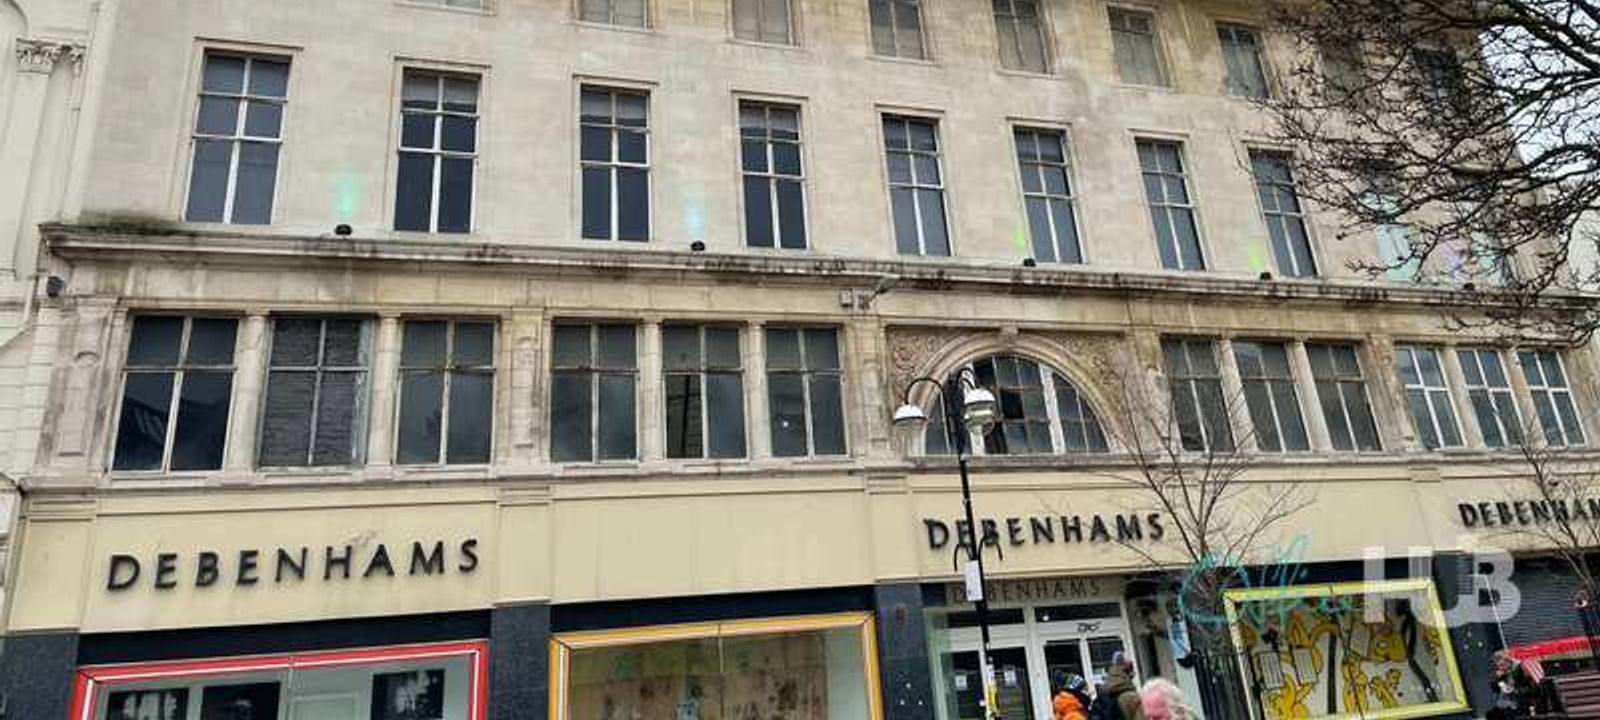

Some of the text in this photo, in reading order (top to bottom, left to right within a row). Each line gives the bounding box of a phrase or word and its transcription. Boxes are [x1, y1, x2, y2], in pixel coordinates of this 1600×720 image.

[923, 513, 1165, 549] DEBENHAMS
[106, 538, 480, 592] DEBENHAMS
[952, 577, 1101, 600] DBENHAMS
